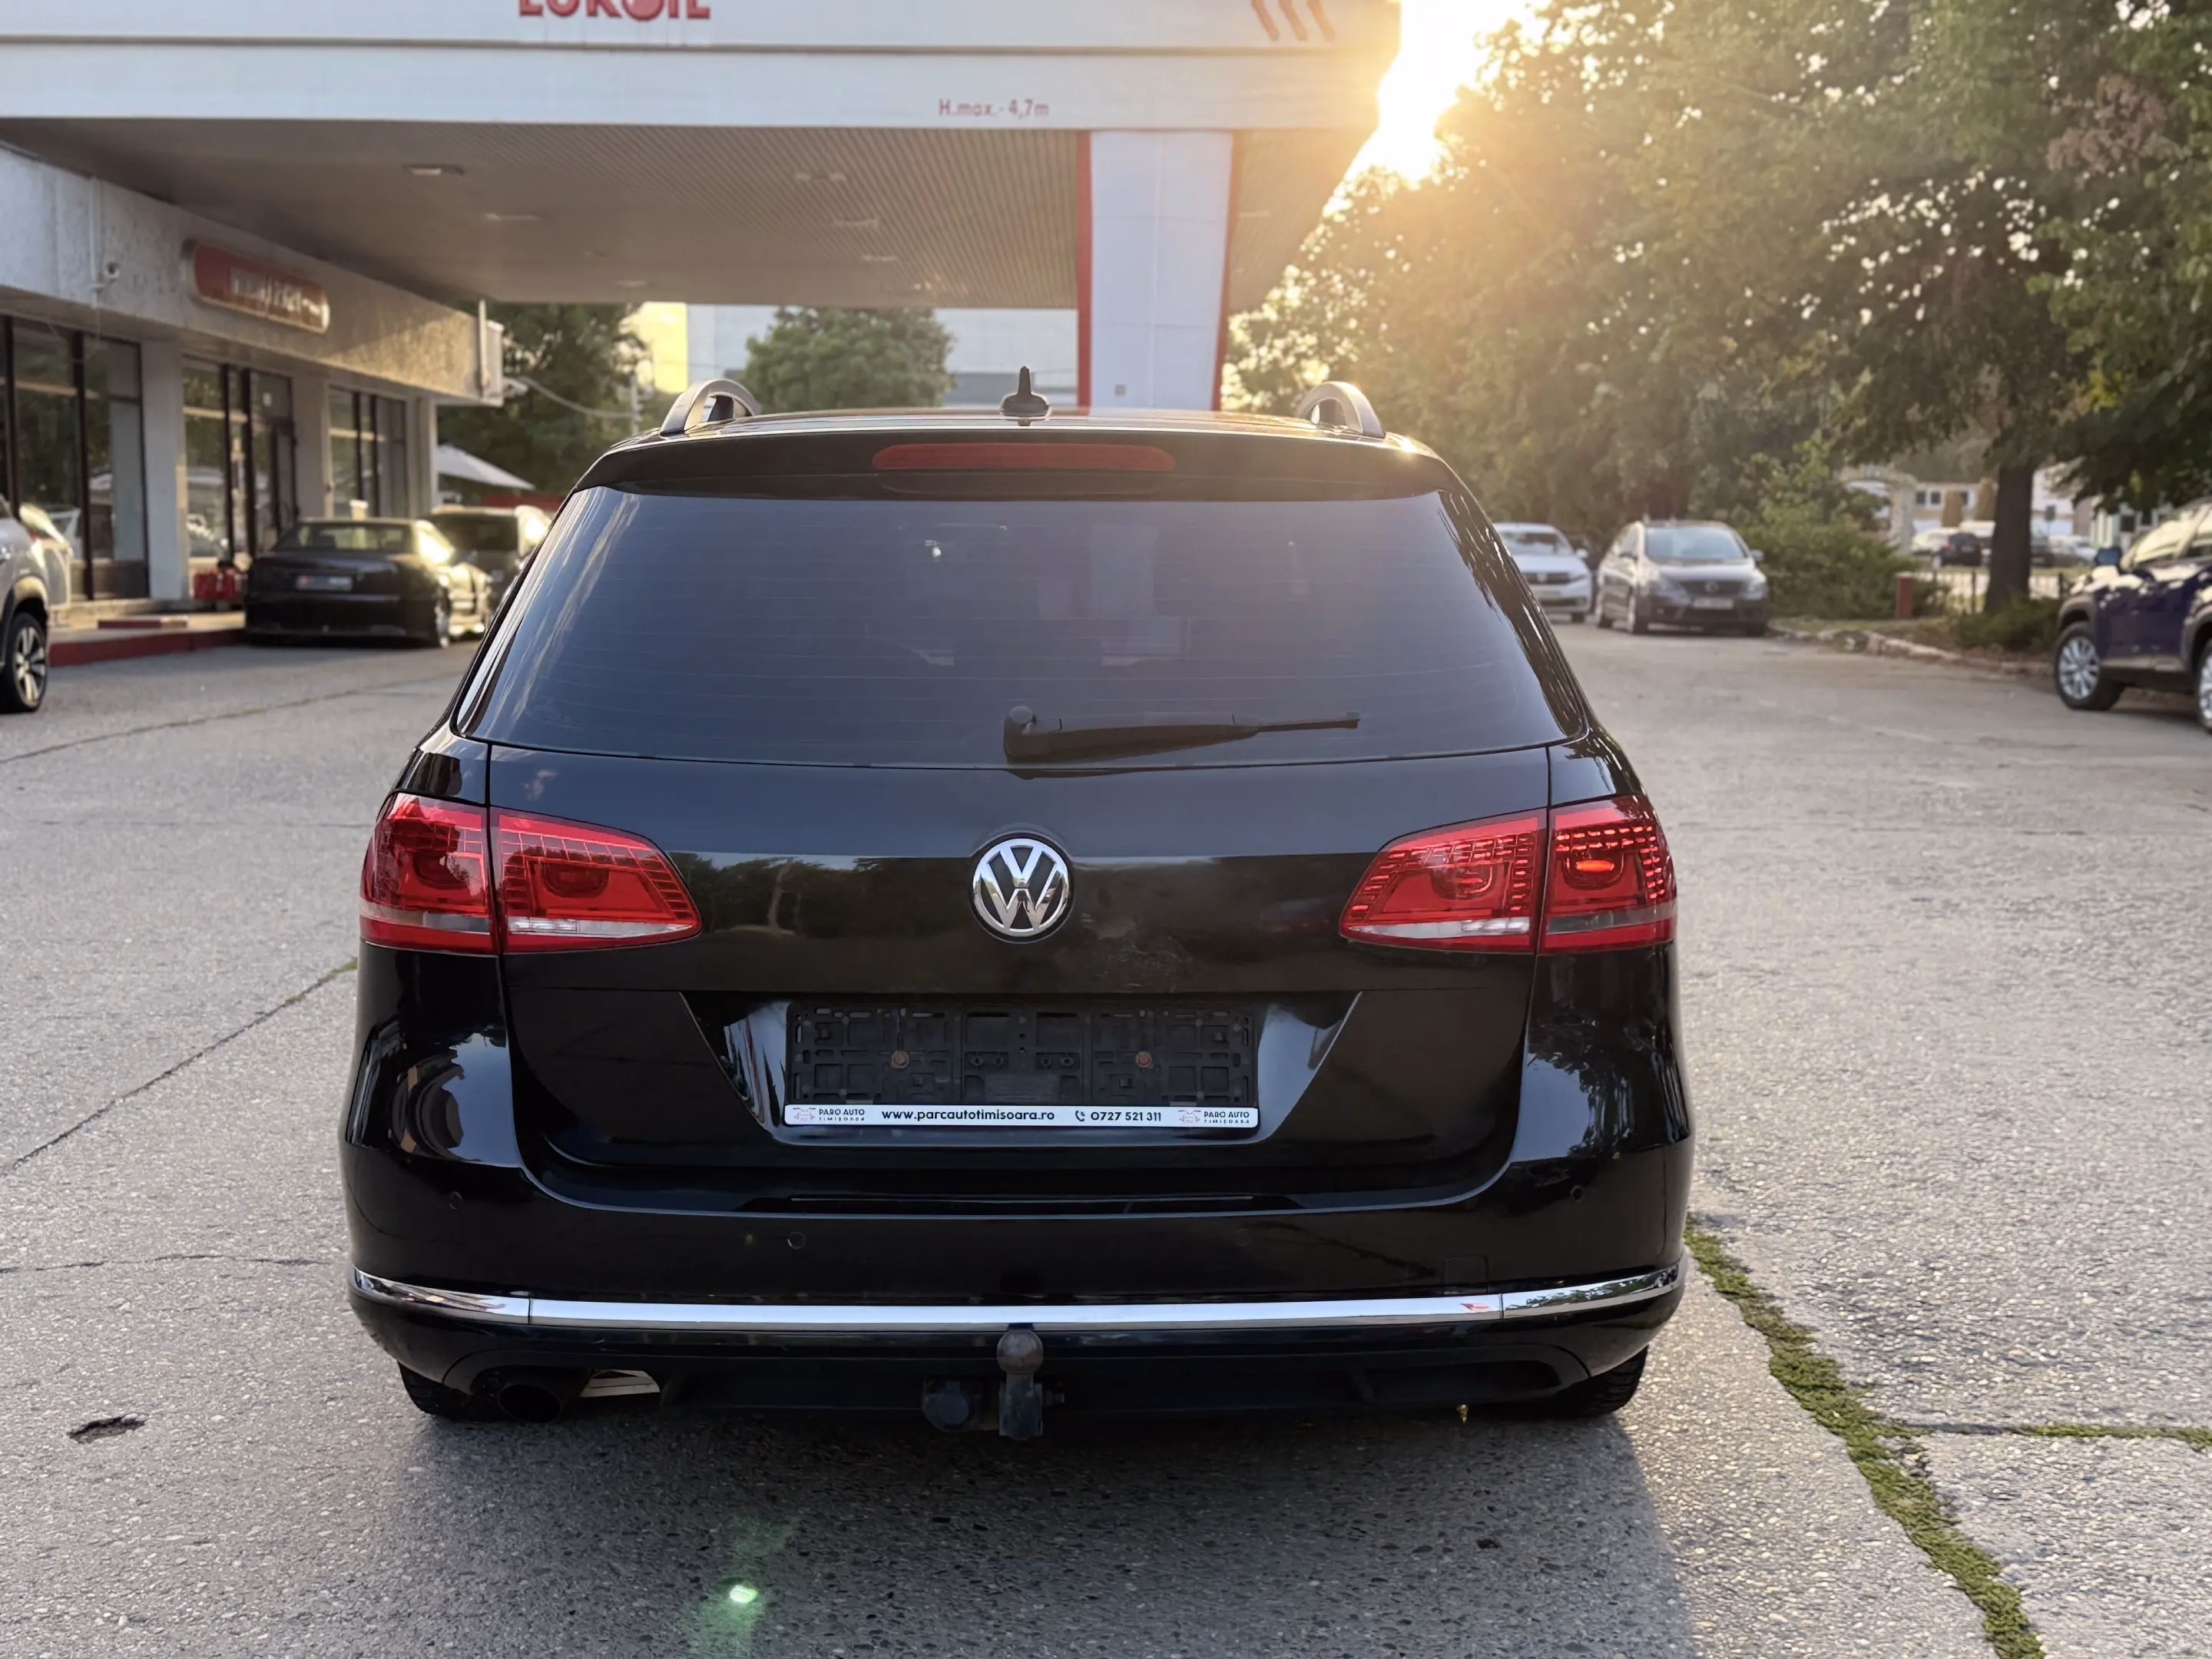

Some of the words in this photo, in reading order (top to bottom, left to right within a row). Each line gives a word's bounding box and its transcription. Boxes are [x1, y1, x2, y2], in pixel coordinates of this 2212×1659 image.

[882, 1109, 1055, 1121] www.parcautotimisoara.ro
[1091, 1111, 1121, 1121] 0727
[1125, 1111, 1143, 1121] 521
[1147, 1111, 1161, 1121] 311
